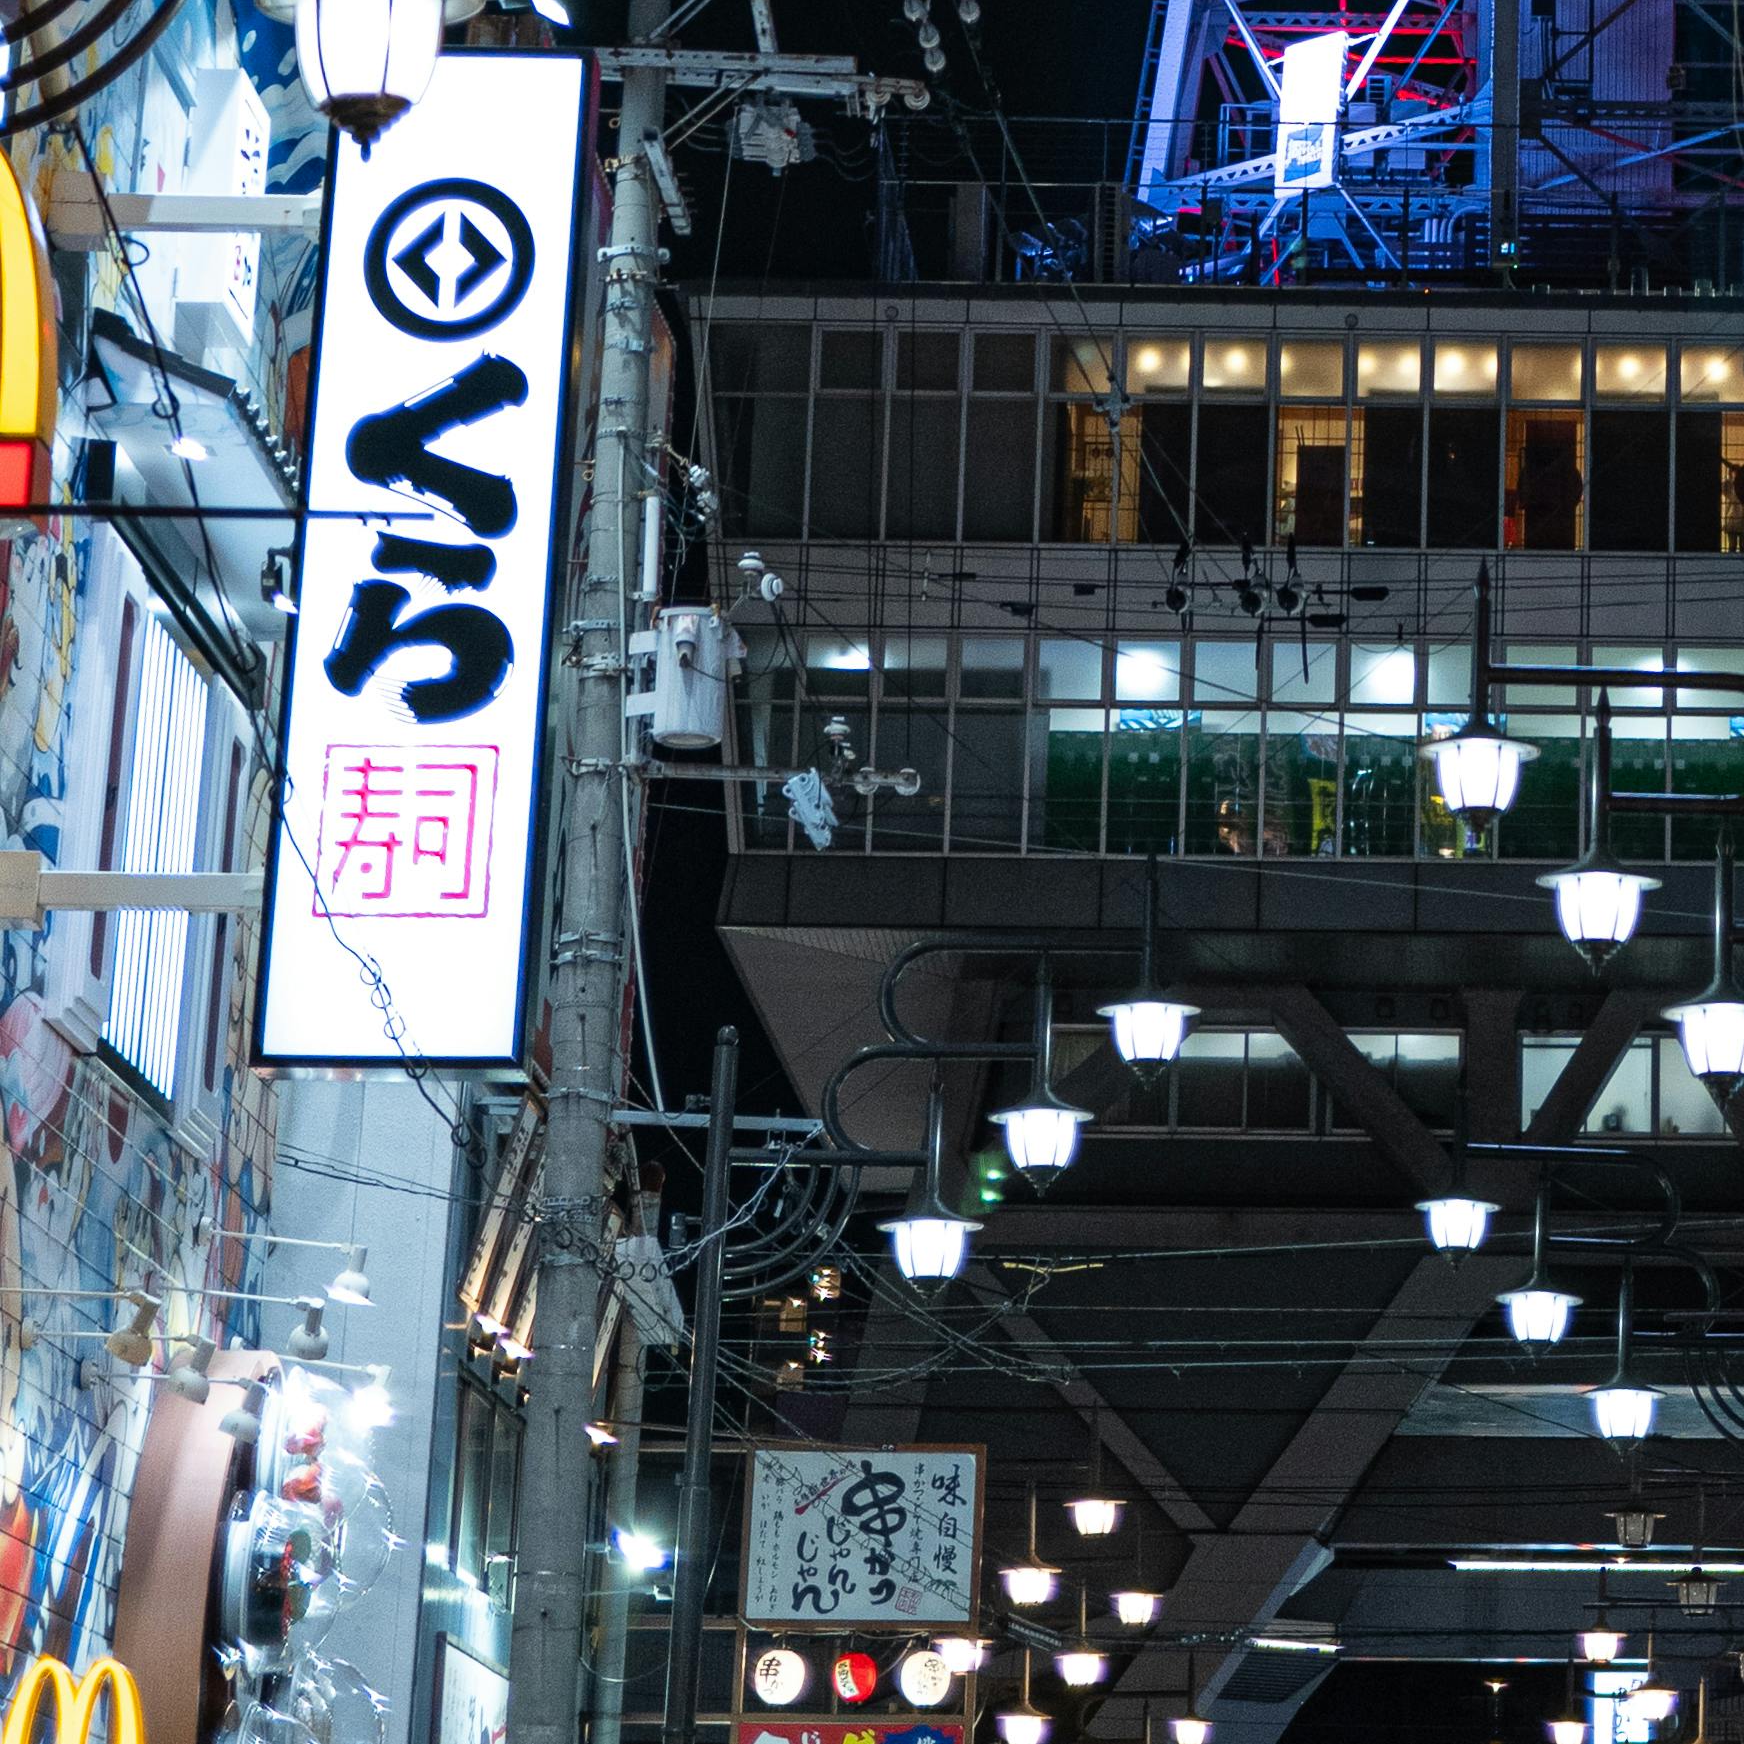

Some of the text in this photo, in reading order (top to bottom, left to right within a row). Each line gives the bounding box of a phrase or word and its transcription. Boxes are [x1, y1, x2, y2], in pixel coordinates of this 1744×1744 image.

[323, 351, 529, 724] くら
[331, 756, 479, 900] 寿司
[931, 1464, 967, 1574] 味自慢
